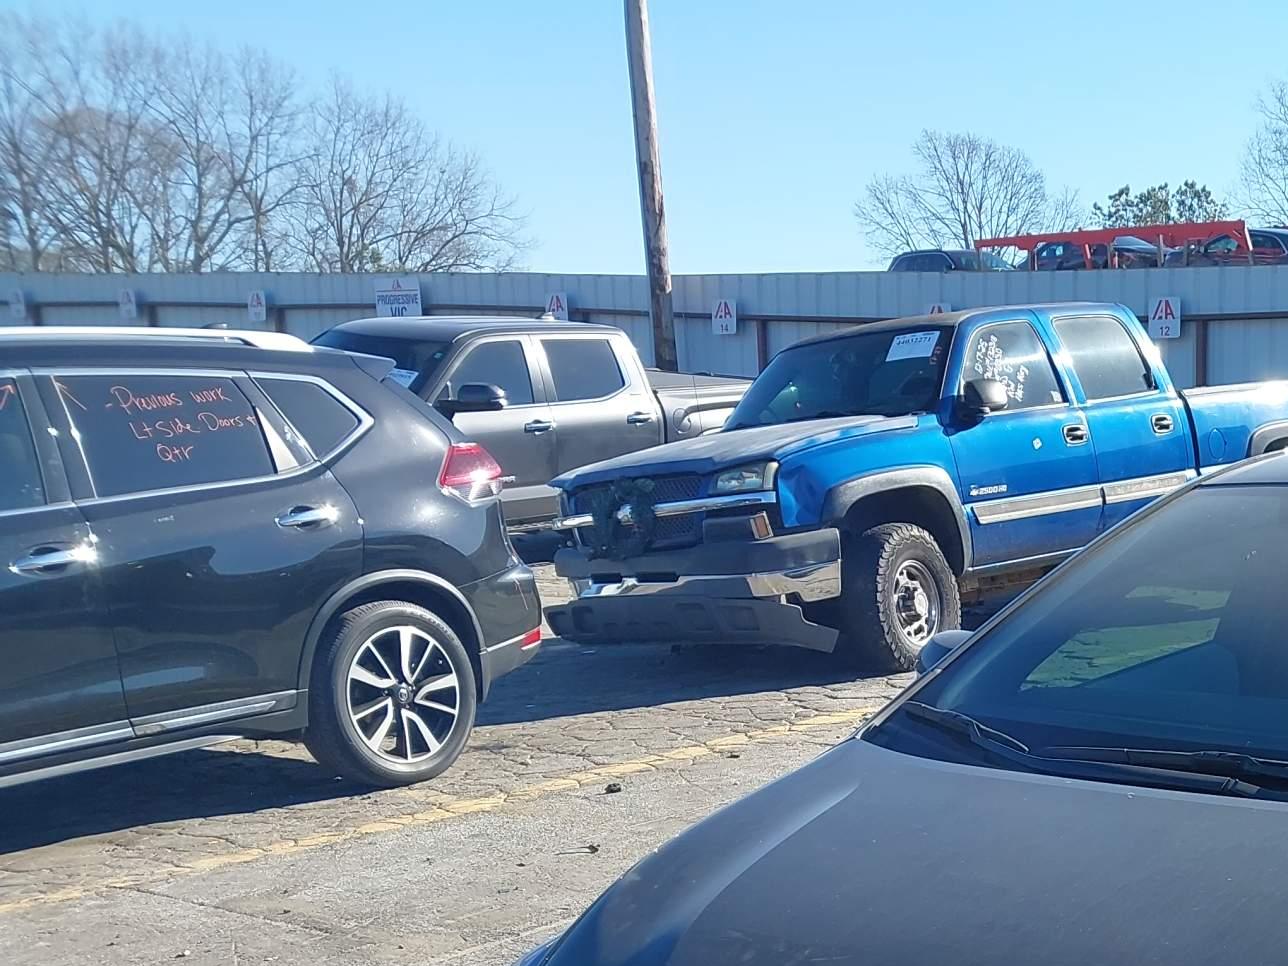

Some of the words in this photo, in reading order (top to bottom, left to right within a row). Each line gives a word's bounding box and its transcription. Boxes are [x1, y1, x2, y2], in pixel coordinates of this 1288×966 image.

[377, 293, 418, 304] PROGRESSIVE
[720, 323, 729, 333] 14
[1160, 326, 1170, 336] 12
